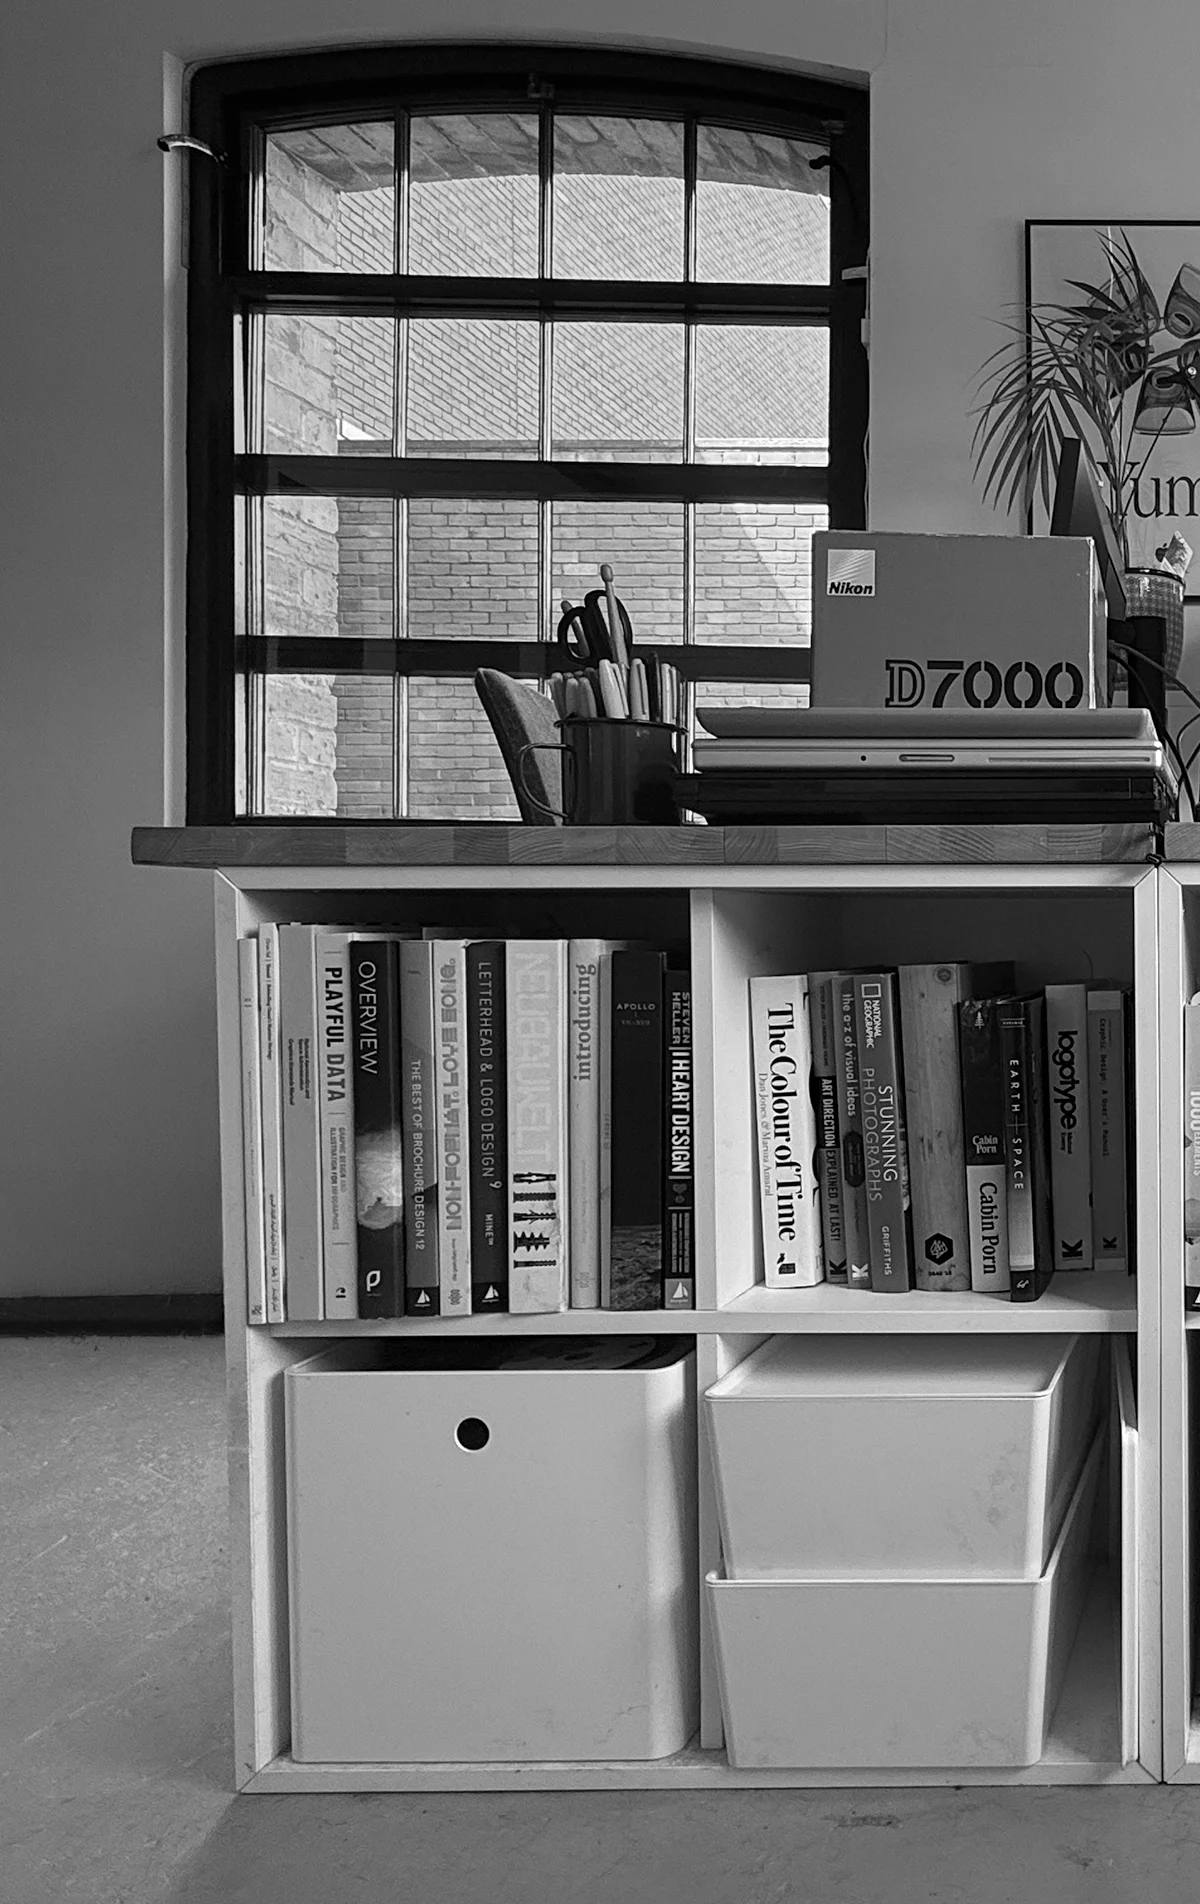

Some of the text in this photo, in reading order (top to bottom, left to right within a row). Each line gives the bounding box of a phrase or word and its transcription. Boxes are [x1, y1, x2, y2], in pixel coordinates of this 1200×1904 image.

[828, 581, 874, 596] Nikon
[884, 658, 1084, 709] D7000
[324, 966, 346, 1102] PLAYFUL DATA
[357, 961, 378, 1074] OVERVIEW
[478, 962, 493, 1057] LETTERHEAD
[572, 963, 597, 1081] introducing
[672, 991, 681, 1045] HELLER
[682, 991, 691, 1044] STEVEN
[766, 1002, 796, 1054] The
[863, 999, 875, 1049] GEOGRAPHIC
[873, 999, 882, 1038] NATIONAL
[1098, 1018, 1107, 1049] Graphic
[441, 1027, 461, 1087] LOVE
[480, 1062, 493, 1073] &
[842, 993, 863, 1117] the a-z of visual ideas
[1051, 1029, 1081, 1130] logotype
[480, 1079, 494, 1117] LOGO
[671, 1059, 690, 1112] HEART
[770, 1055, 799, 1143] Colour
[821, 1078, 834, 1097] ART
[330, 1127, 339, 1171] ILLUSTRATION
[671, 1113, 690, 1173] DESIGN
[757, 1072, 774, 1197] Dan Jones & Marina Amaral
[822, 1098, 837, 1148] DIRECTION
[861, 1067, 883, 1202] PHOTOGRAPHS
[877, 1085, 899, 1182] STUNNING
[972, 1134, 998, 1145] Cabin
[976, 1145, 997, 1154] Porn
[1008, 1059, 1024, 1190] EARTH SPACE
[1101, 1129, 1110, 1157] Manual
[412, 1059, 425, 1251] THE BEST OF BROCHURE DESIGN 12
[481, 1123, 495, 1177] DESIGN
[773, 1144, 802, 1173] of
[331, 1171, 339, 1184] FOR
[775, 1173, 804, 1242] Time
[828, 1203, 840, 1214] AT
[828, 1216, 841, 1241] LAST!
[978, 1181, 1000, 1275] Cabin Porn
[880, 1225, 893, 1276] GRIFFITHS
